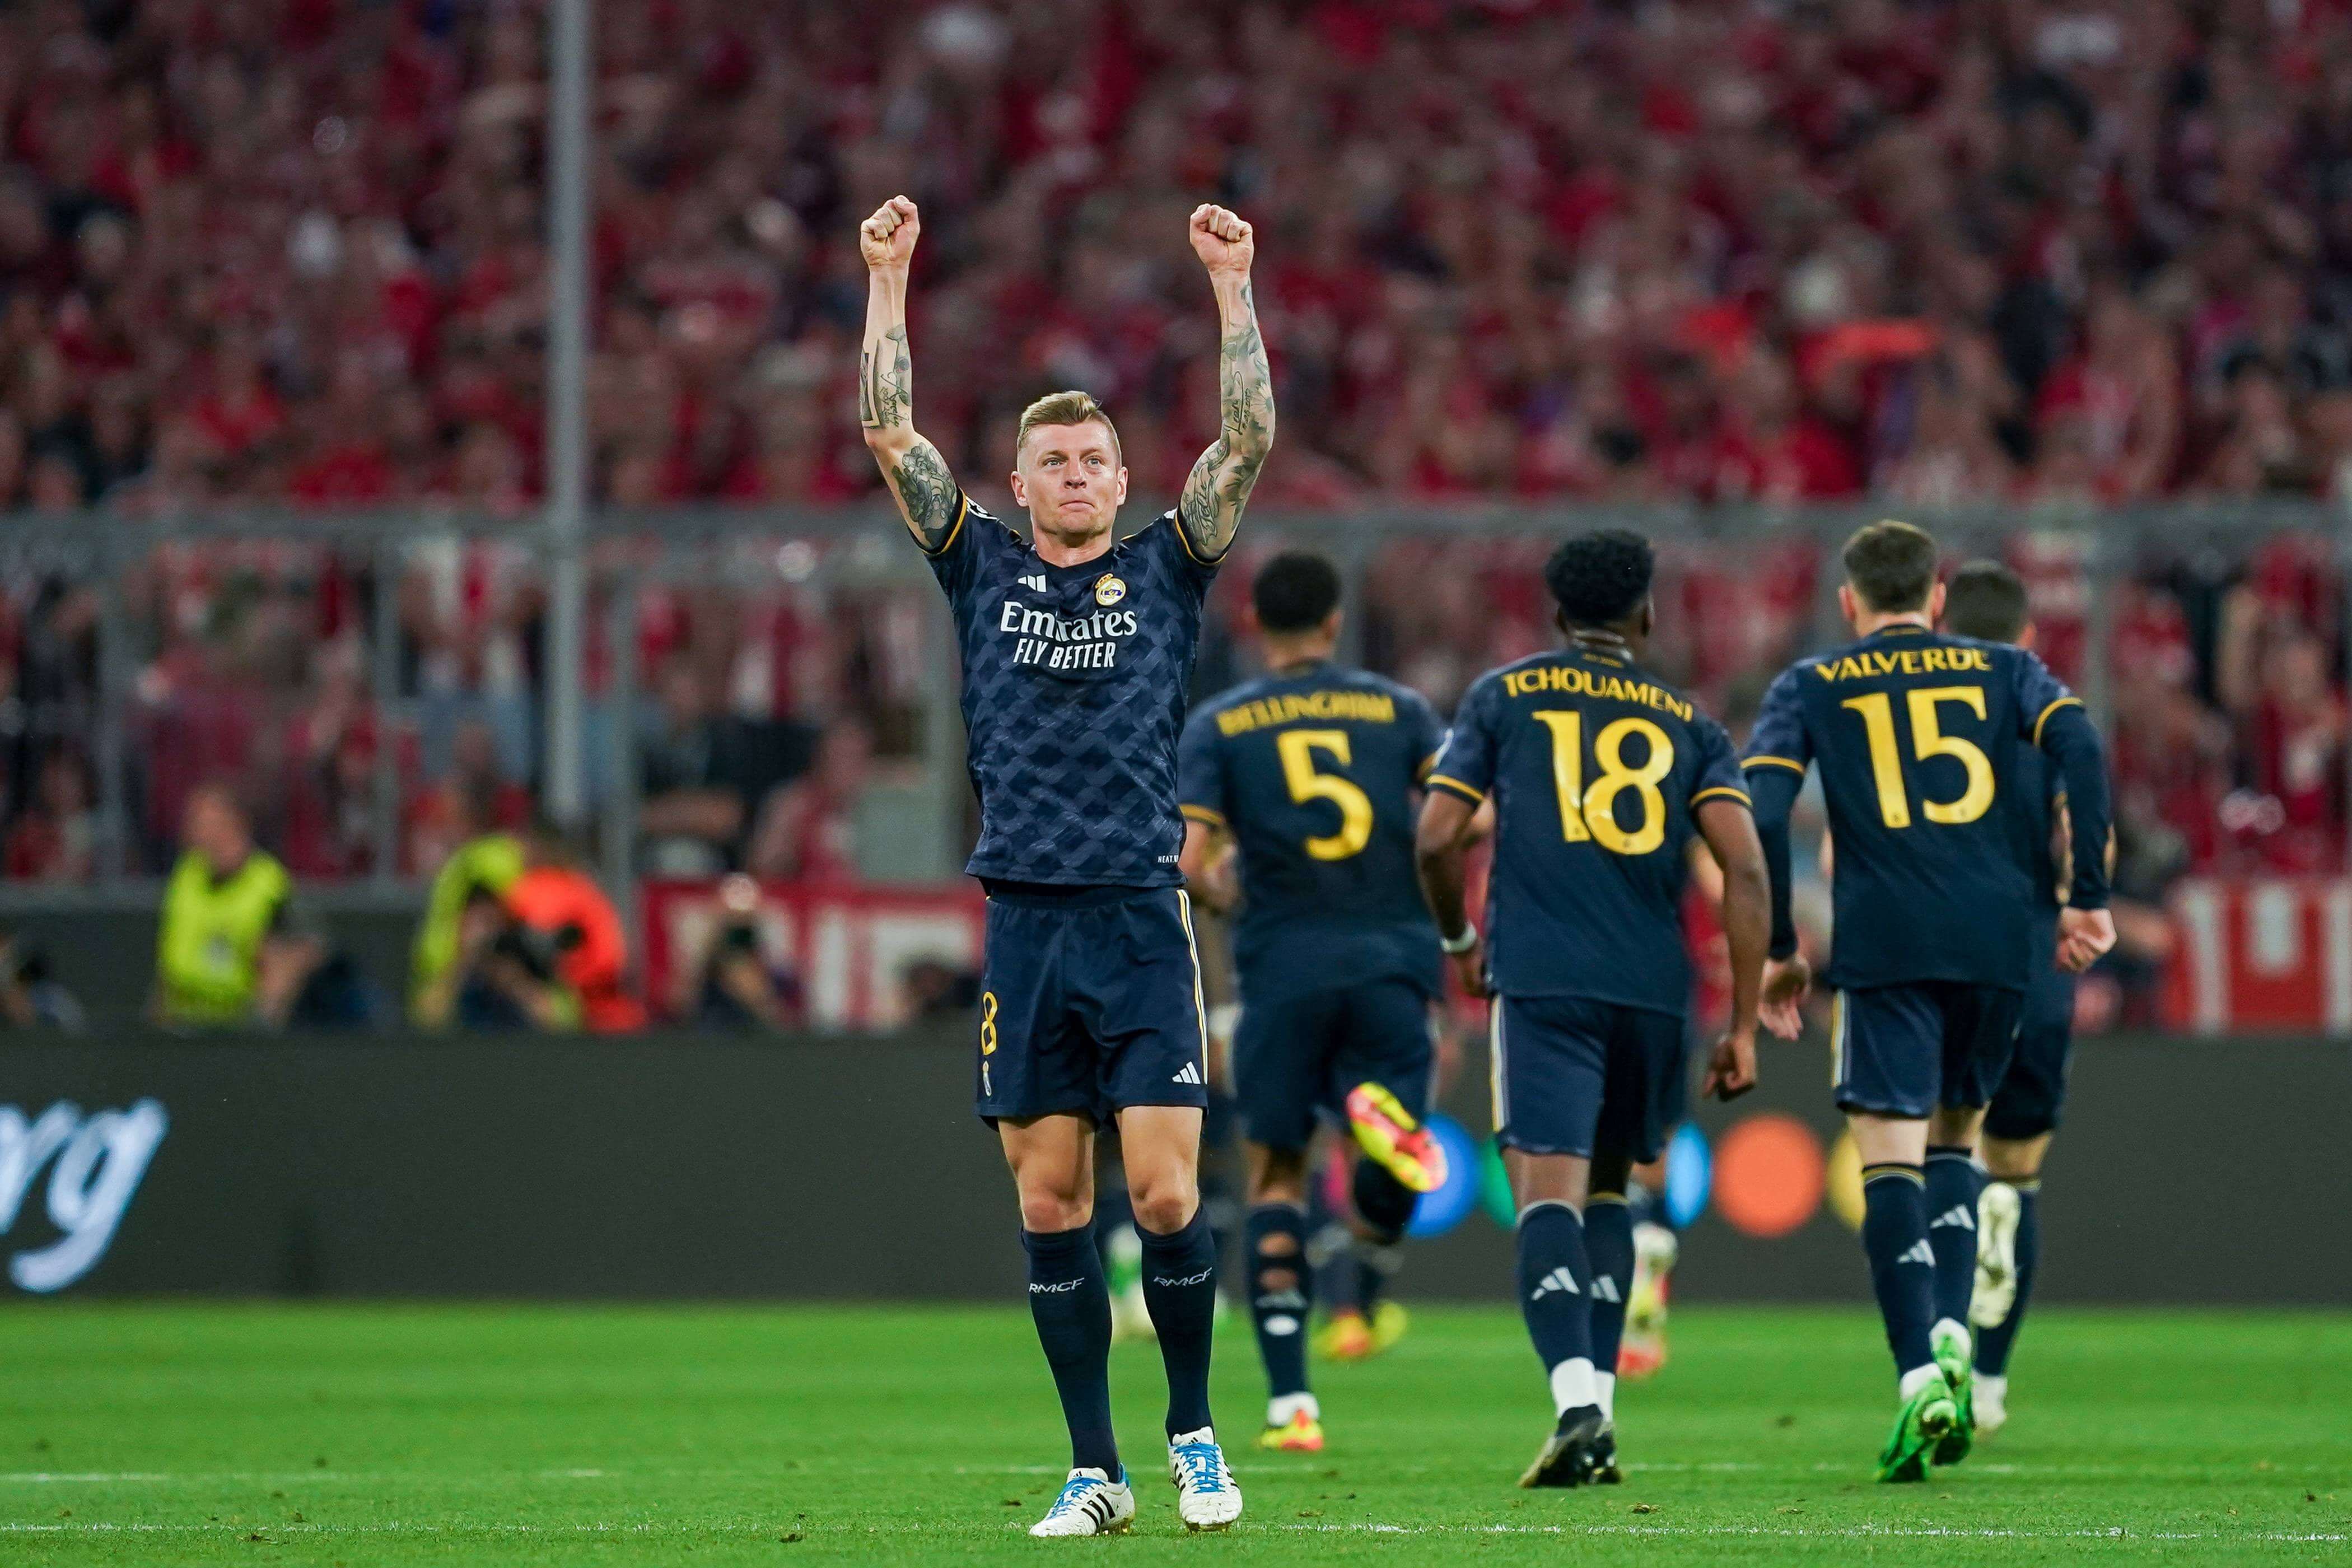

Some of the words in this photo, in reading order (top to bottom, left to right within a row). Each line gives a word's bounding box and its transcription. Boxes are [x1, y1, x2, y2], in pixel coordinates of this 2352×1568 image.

[1012, 637, 1049, 665] FLY
[1048, 641, 1117, 670] BETTER
[1814, 646, 1992, 683] VALVERDE
[1502, 666, 1693, 722] TCHOUAMENI
[1532, 710, 1674, 856] 18
[1840, 685, 1995, 828] 15
[1276, 729, 1374, 861] 5
[981, 991, 998, 1056] 8
[1029, 1277, 1085, 1293] RMCF
